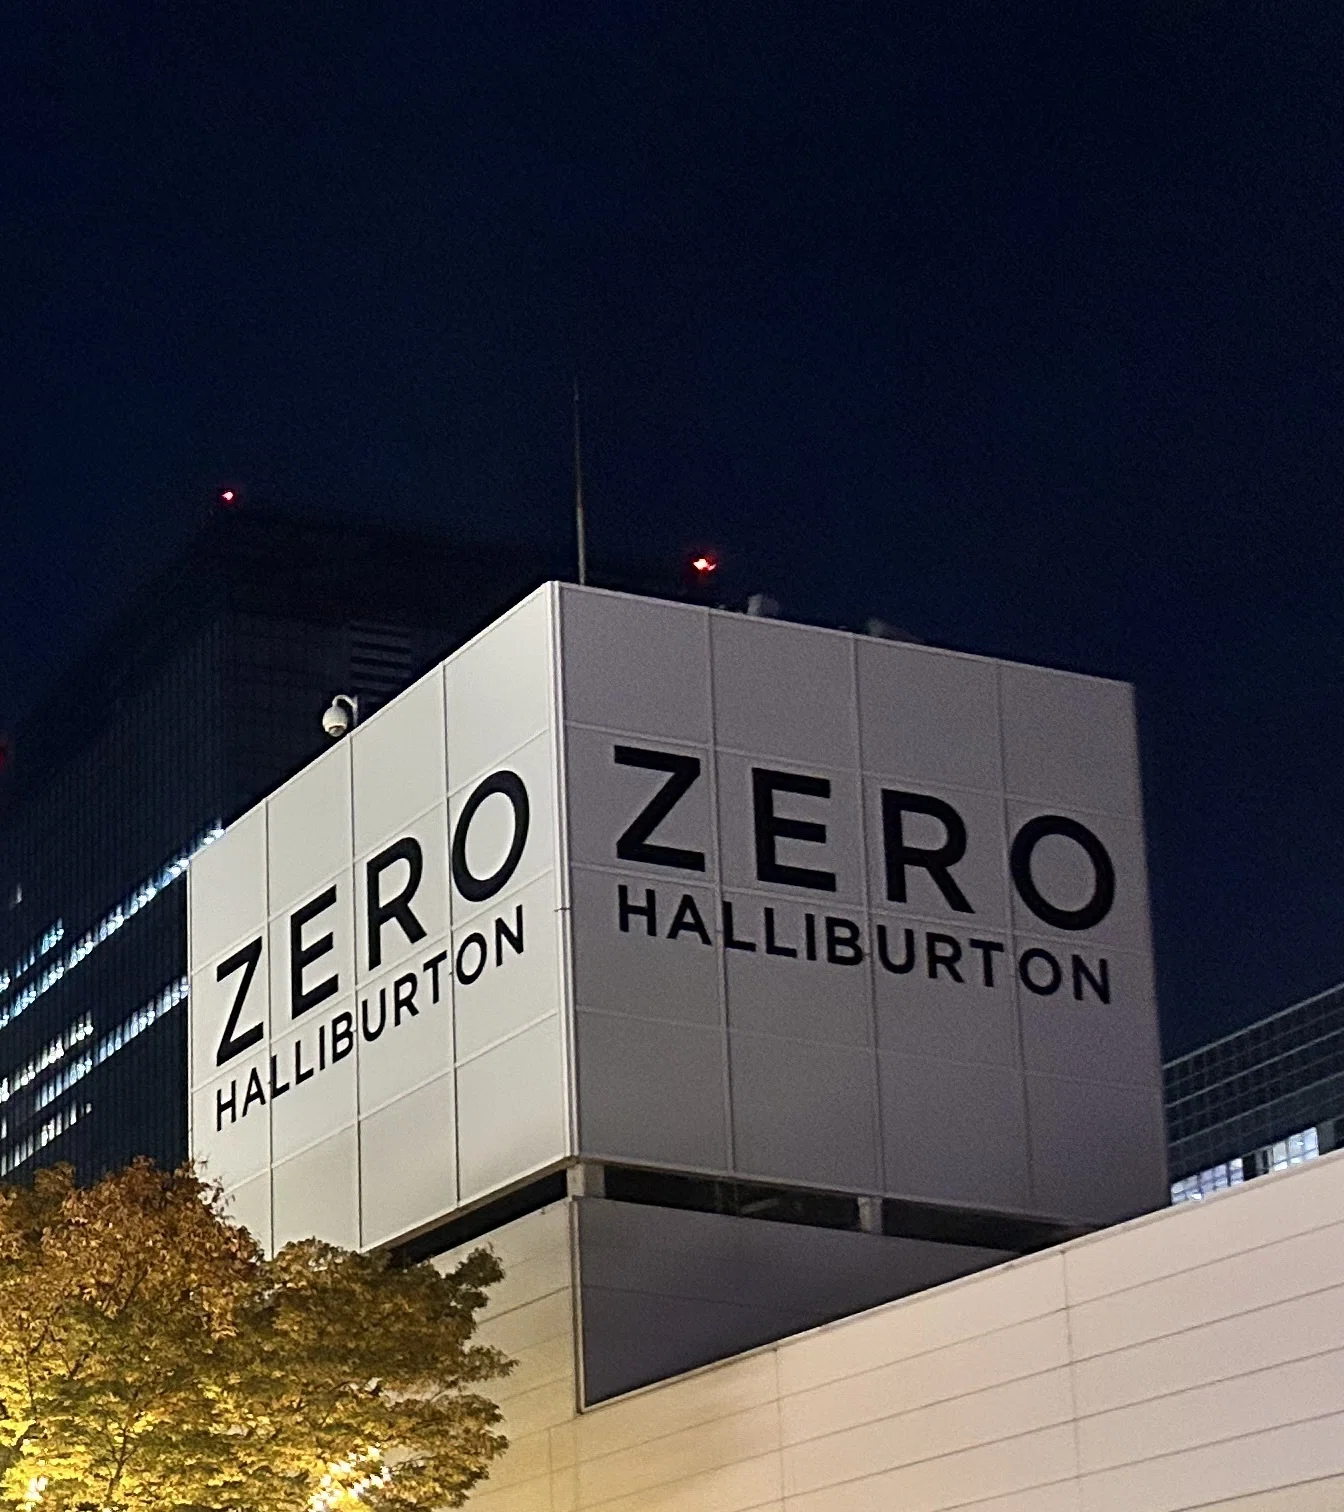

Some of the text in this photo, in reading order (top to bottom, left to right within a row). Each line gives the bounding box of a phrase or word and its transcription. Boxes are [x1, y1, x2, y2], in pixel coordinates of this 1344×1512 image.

[215, 770, 529, 1066] ZERO
[613, 745, 1116, 931] ZERO
[215, 904, 525, 1131] HALLIBURTON
[616, 884, 1112, 1005] HALLIBURTON
